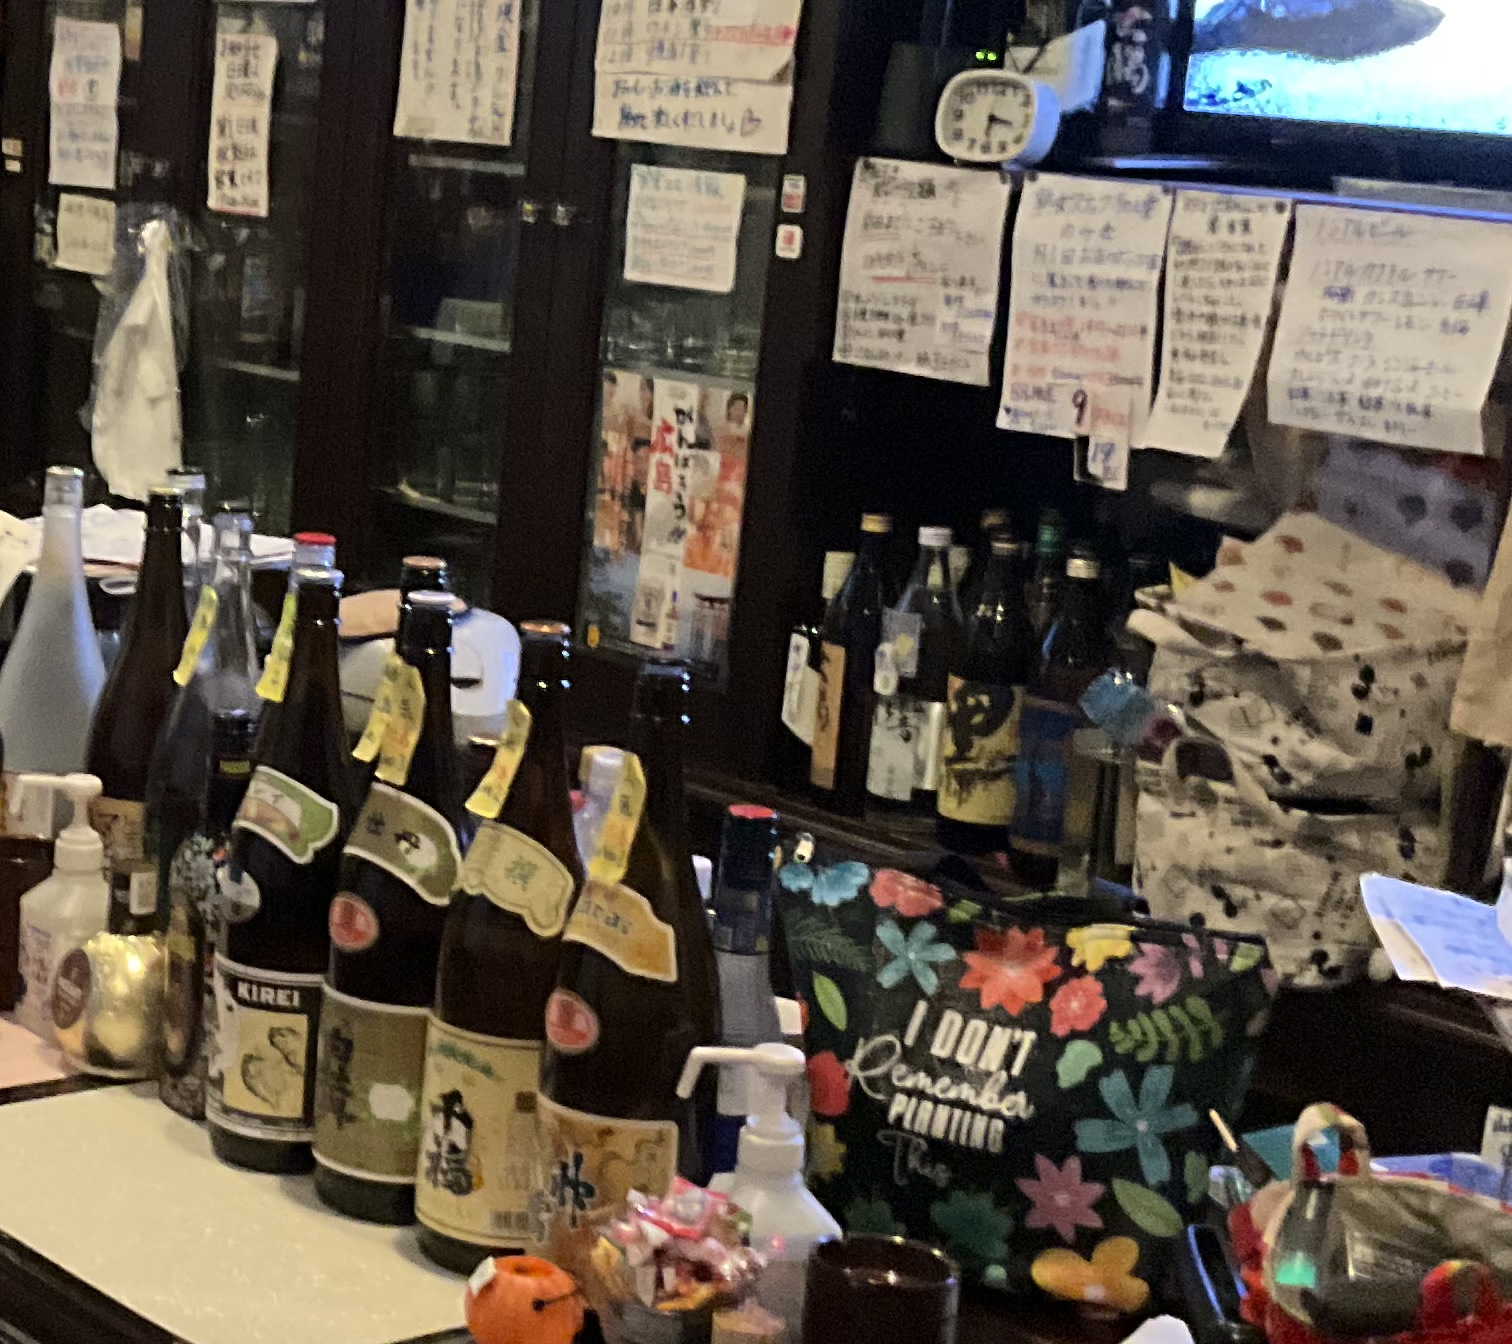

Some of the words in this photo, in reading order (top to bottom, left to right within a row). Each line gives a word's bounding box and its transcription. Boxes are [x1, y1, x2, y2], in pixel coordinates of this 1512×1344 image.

[238, 979, 300, 1007] KIREI
[904, 999, 929, 1048] I
[930, 1008, 1038, 1077] DON'T
[845, 1034, 1036, 1120] Remember
[888, 1092, 1006, 1154] PLANTING
